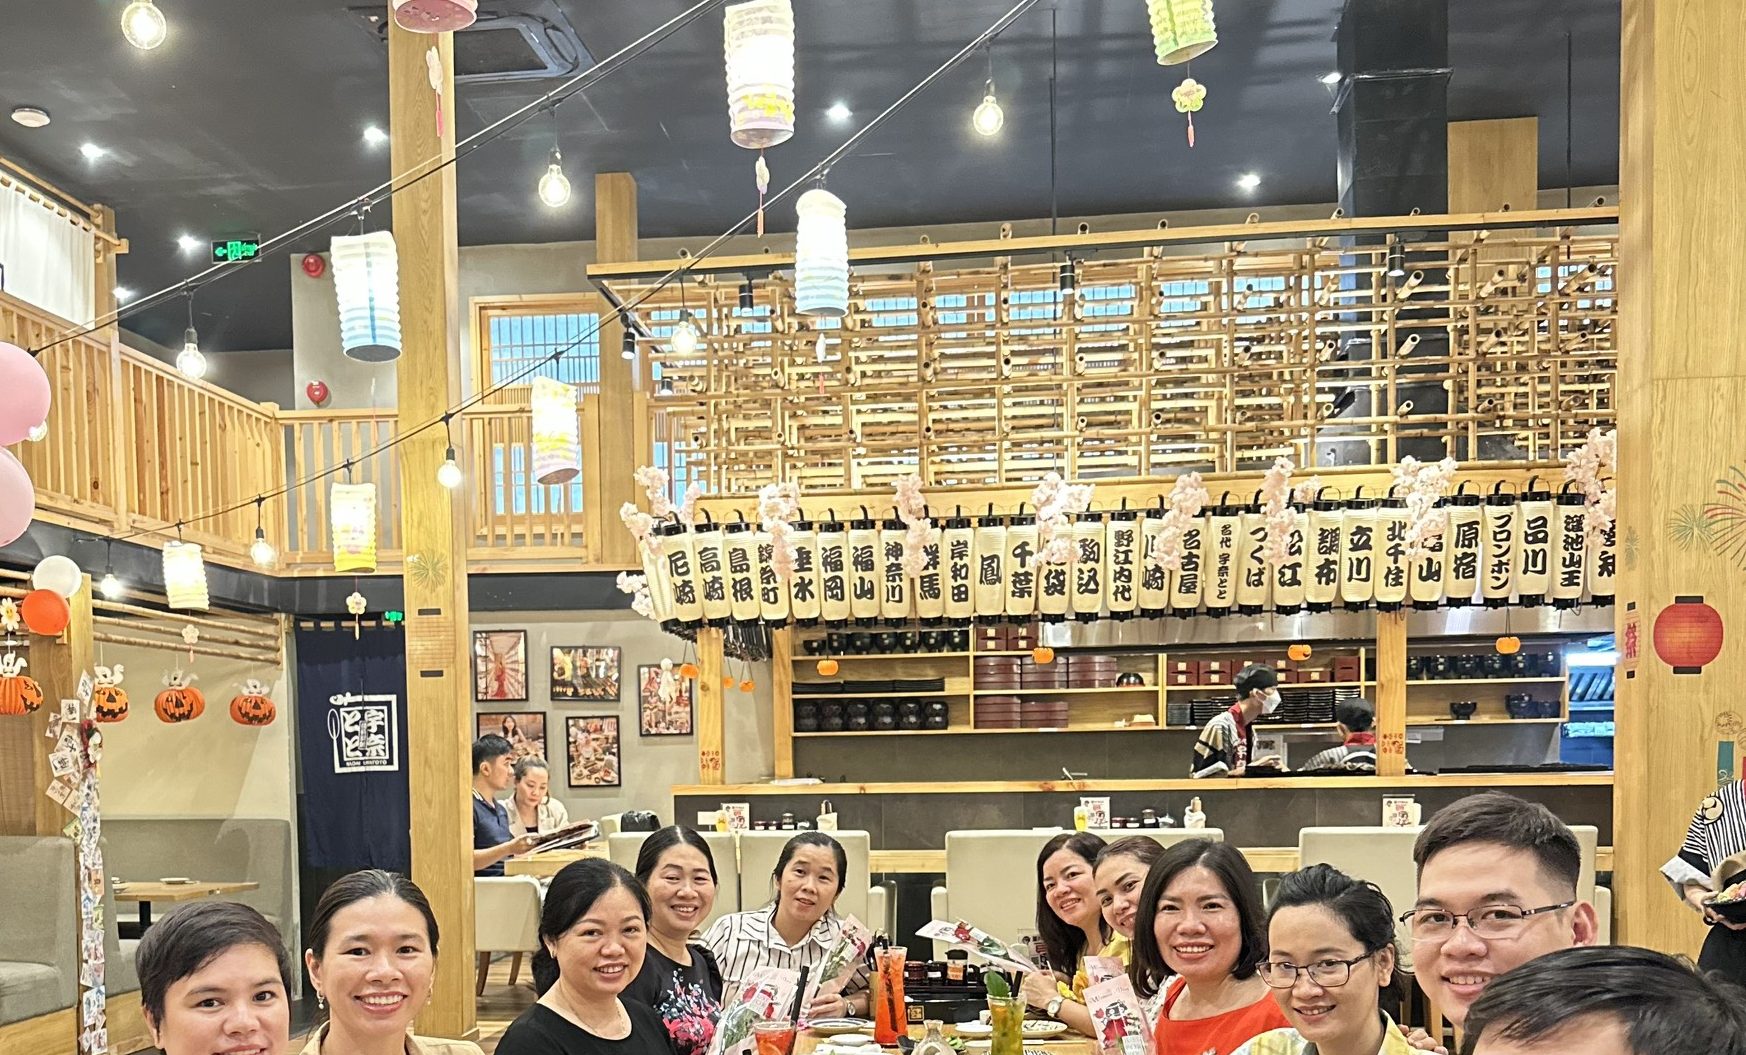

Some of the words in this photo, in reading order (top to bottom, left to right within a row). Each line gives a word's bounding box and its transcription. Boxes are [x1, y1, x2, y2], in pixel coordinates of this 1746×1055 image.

[697, 546, 724, 601] 高崎
[728, 547, 754, 602] 島根
[821, 546, 844, 602] 福岡
[852, 545, 874, 601] 福山
[885, 541, 904, 603] 神奈川
[950, 540, 969, 603] 岸和田
[980, 553, 1002, 586] 鳳
[1011, 541, 1033, 598] 千葉
[1113, 529, 1134, 602] 野江内代
[1178, 528, 1200, 594] 名古屋
[1246, 527, 1268, 588] つくば
[1348, 525, 1373, 583] 立川
[1384, 521, 1408, 587] 北千住
[1453, 520, 1480, 580] 原宿
[1490, 511, 1514, 590] プロンポン
[1523, 515, 1548, 575] 品川
[1044, 559, 1066, 596] 袋
